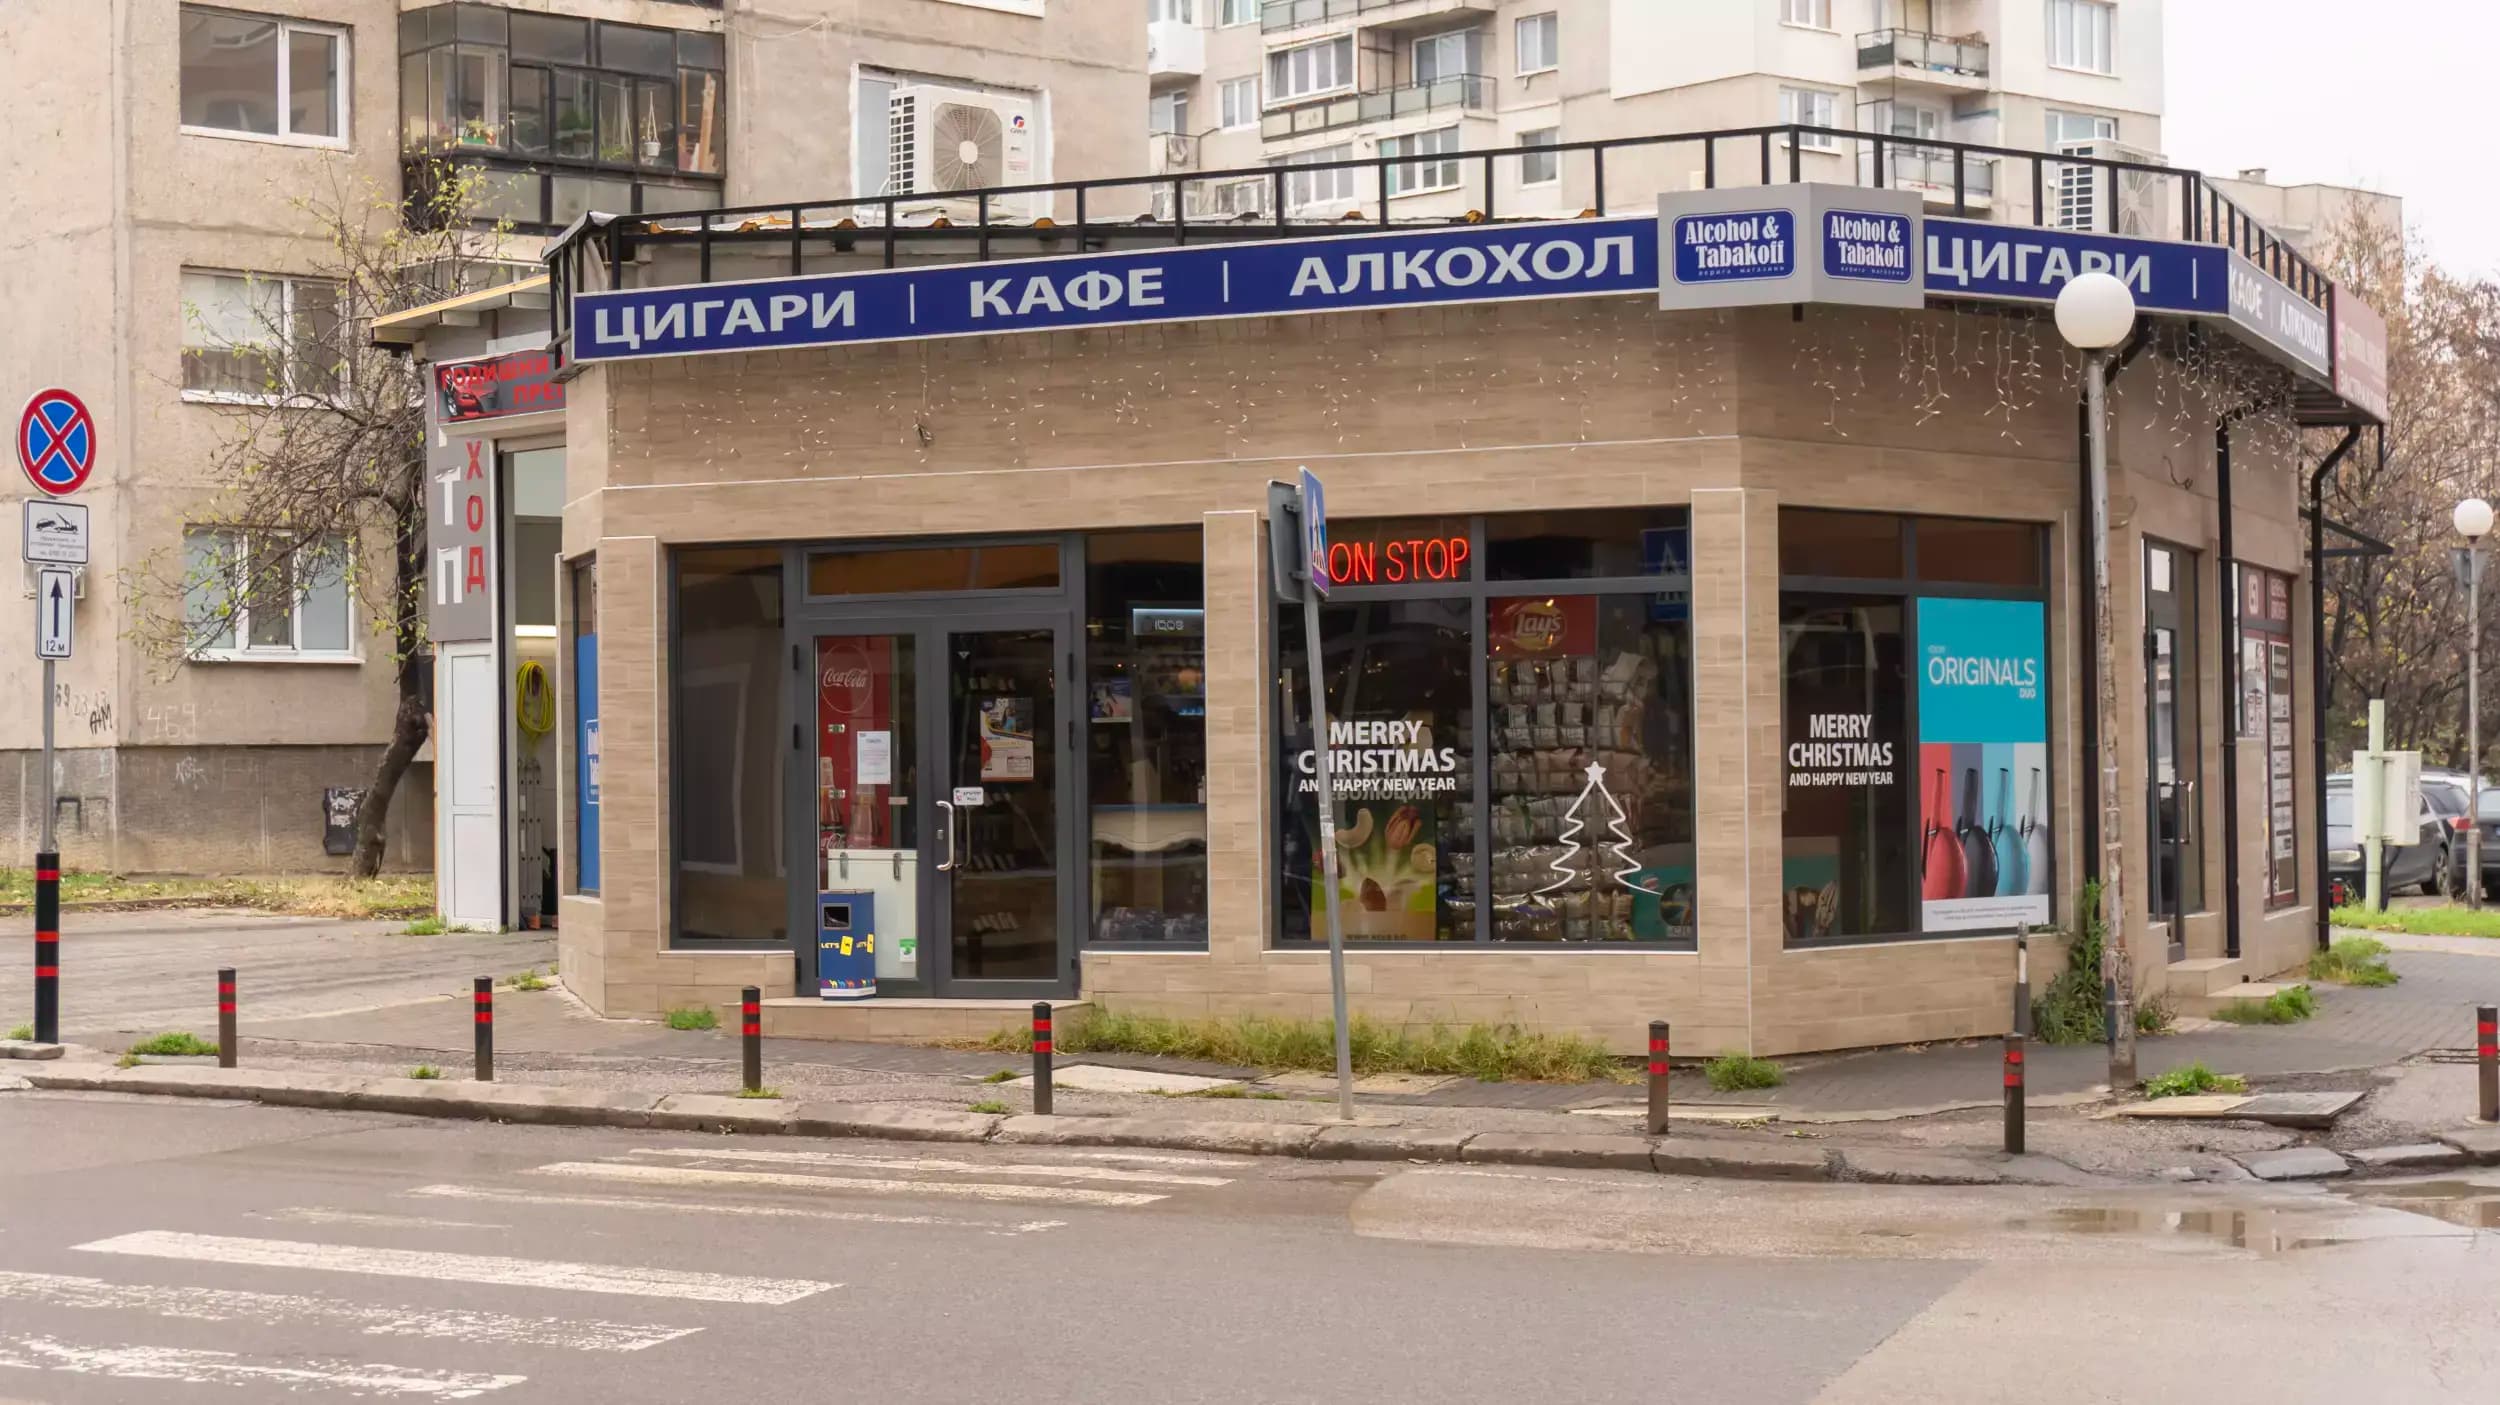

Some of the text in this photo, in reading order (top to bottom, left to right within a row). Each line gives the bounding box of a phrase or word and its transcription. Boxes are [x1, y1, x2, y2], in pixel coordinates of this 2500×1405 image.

[1685, 215, 1780, 244] Alcohol &
[1830, 215, 1901, 243] Alcohol &
[1289, 235, 1635, 296] АЛКОХОЛ
[1696, 240, 1785, 269] Tabakoff
[1838, 241, 1905, 268] Tabakoff
[1927, 235, 2150, 293] ЦИГАРИ
[970, 267, 1165, 318] КАФЕ
[2229, 264, 2263, 321] КАФЕ
[595, 290, 856, 350] ЦИГАРИ
[1386, 538, 1468, 581] STOP
[45, 639, 56, 652] 12
[1928, 656, 2036, 686] ORIGINALS
[2018, 687, 2036, 699] DUO
[1329, 720, 1423, 745] MERRY
[1809, 713, 1872, 738] MERRY
[1298, 748, 1456, 774] CRISTMAS
[1788, 742, 1893, 767] CHRISTMAS
[1332, 779, 1381, 792] HAPPY
[1383, 779, 1416, 791] NEW
[1418, 778, 1456, 790] YEAR
[1789, 771, 1893, 786] AND HAPPY NEW YEAR
